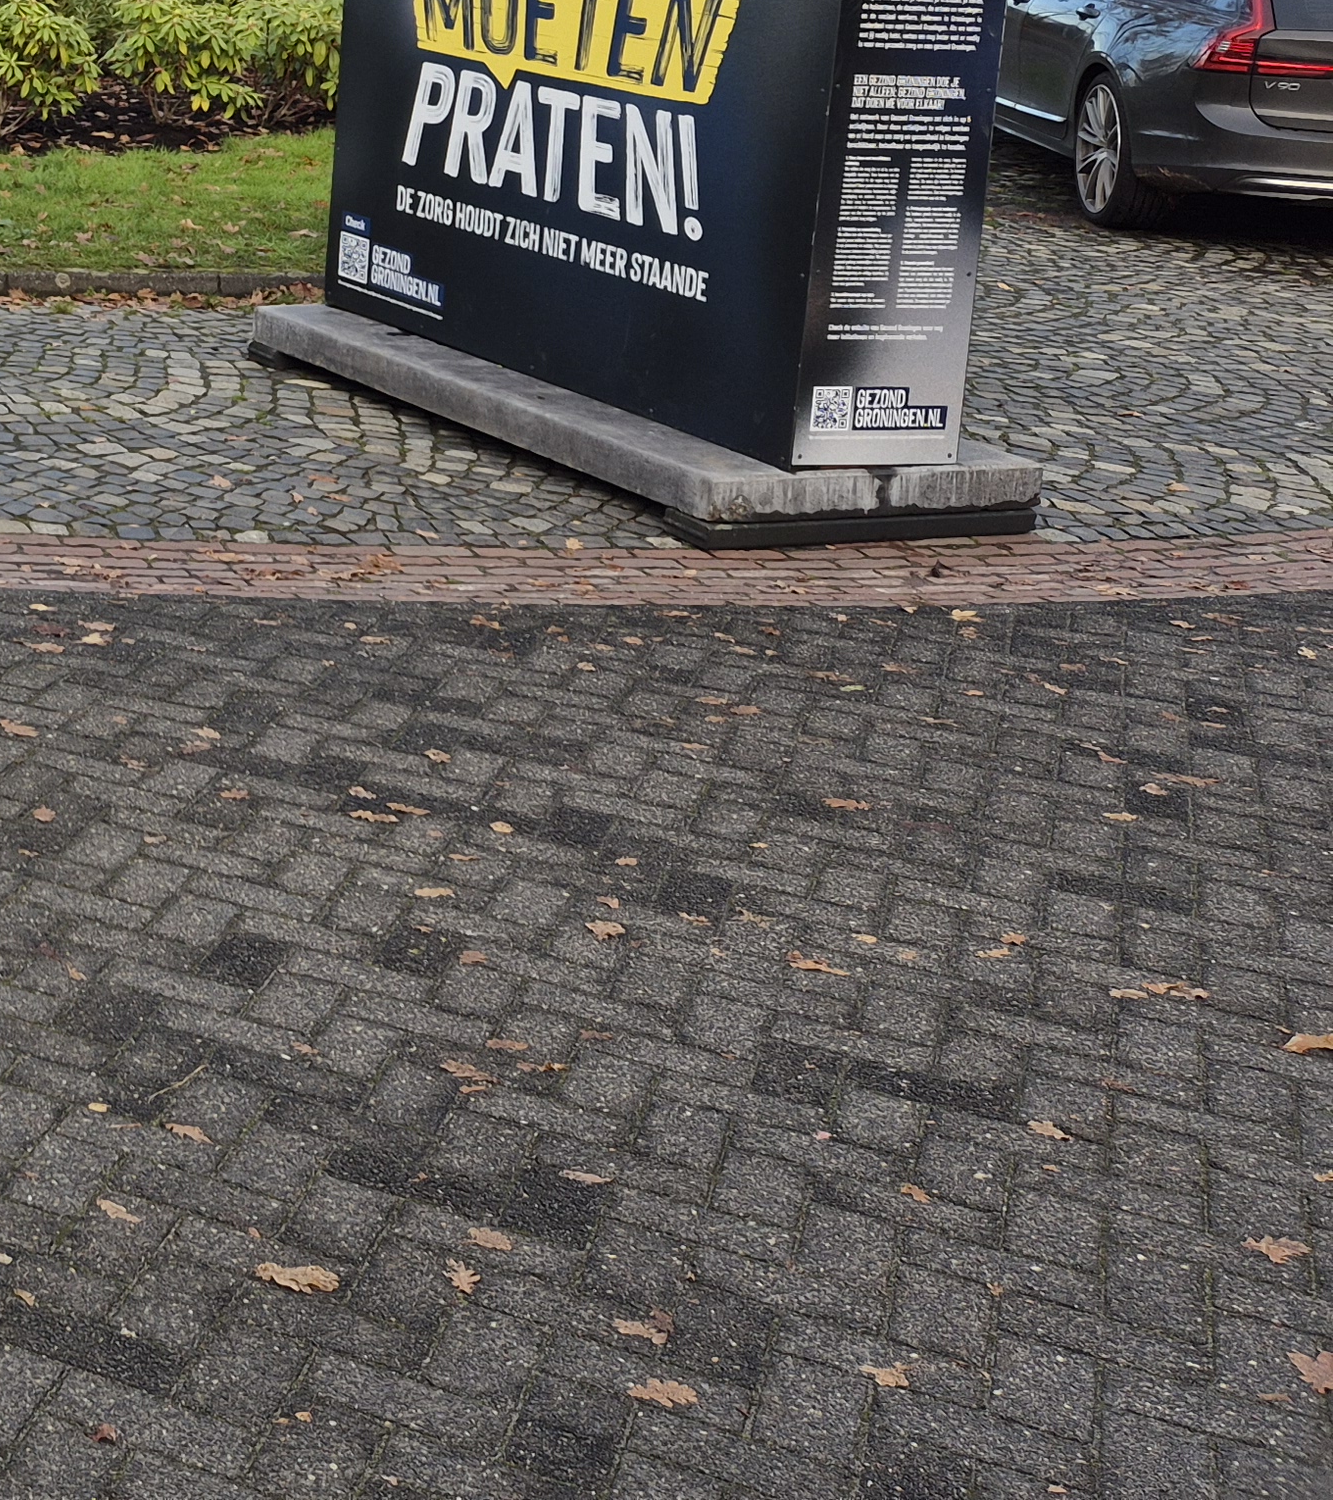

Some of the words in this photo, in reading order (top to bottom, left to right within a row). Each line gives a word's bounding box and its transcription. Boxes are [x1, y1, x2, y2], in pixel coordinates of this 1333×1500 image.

[1265, 80, 1301, 91] V90
[402, 61, 703, 241] PRATEN!
[372, 244, 411, 274] GEZOND
[396, 185, 415, 214] DE
[416, 190, 453, 226] ZORG
[455, 202, 503, 240] HOUDT
[505, 216, 540, 252] ZICH
[542, 226, 579, 263] NIET
[581, 237, 628, 279] MEER
[630, 252, 709, 303] STAANDE
[370, 265, 442, 306] GRONINGEN.NL
[856, 389, 906, 408] GEZOND
[854, 409, 944, 428] GRONINGEN.NL
